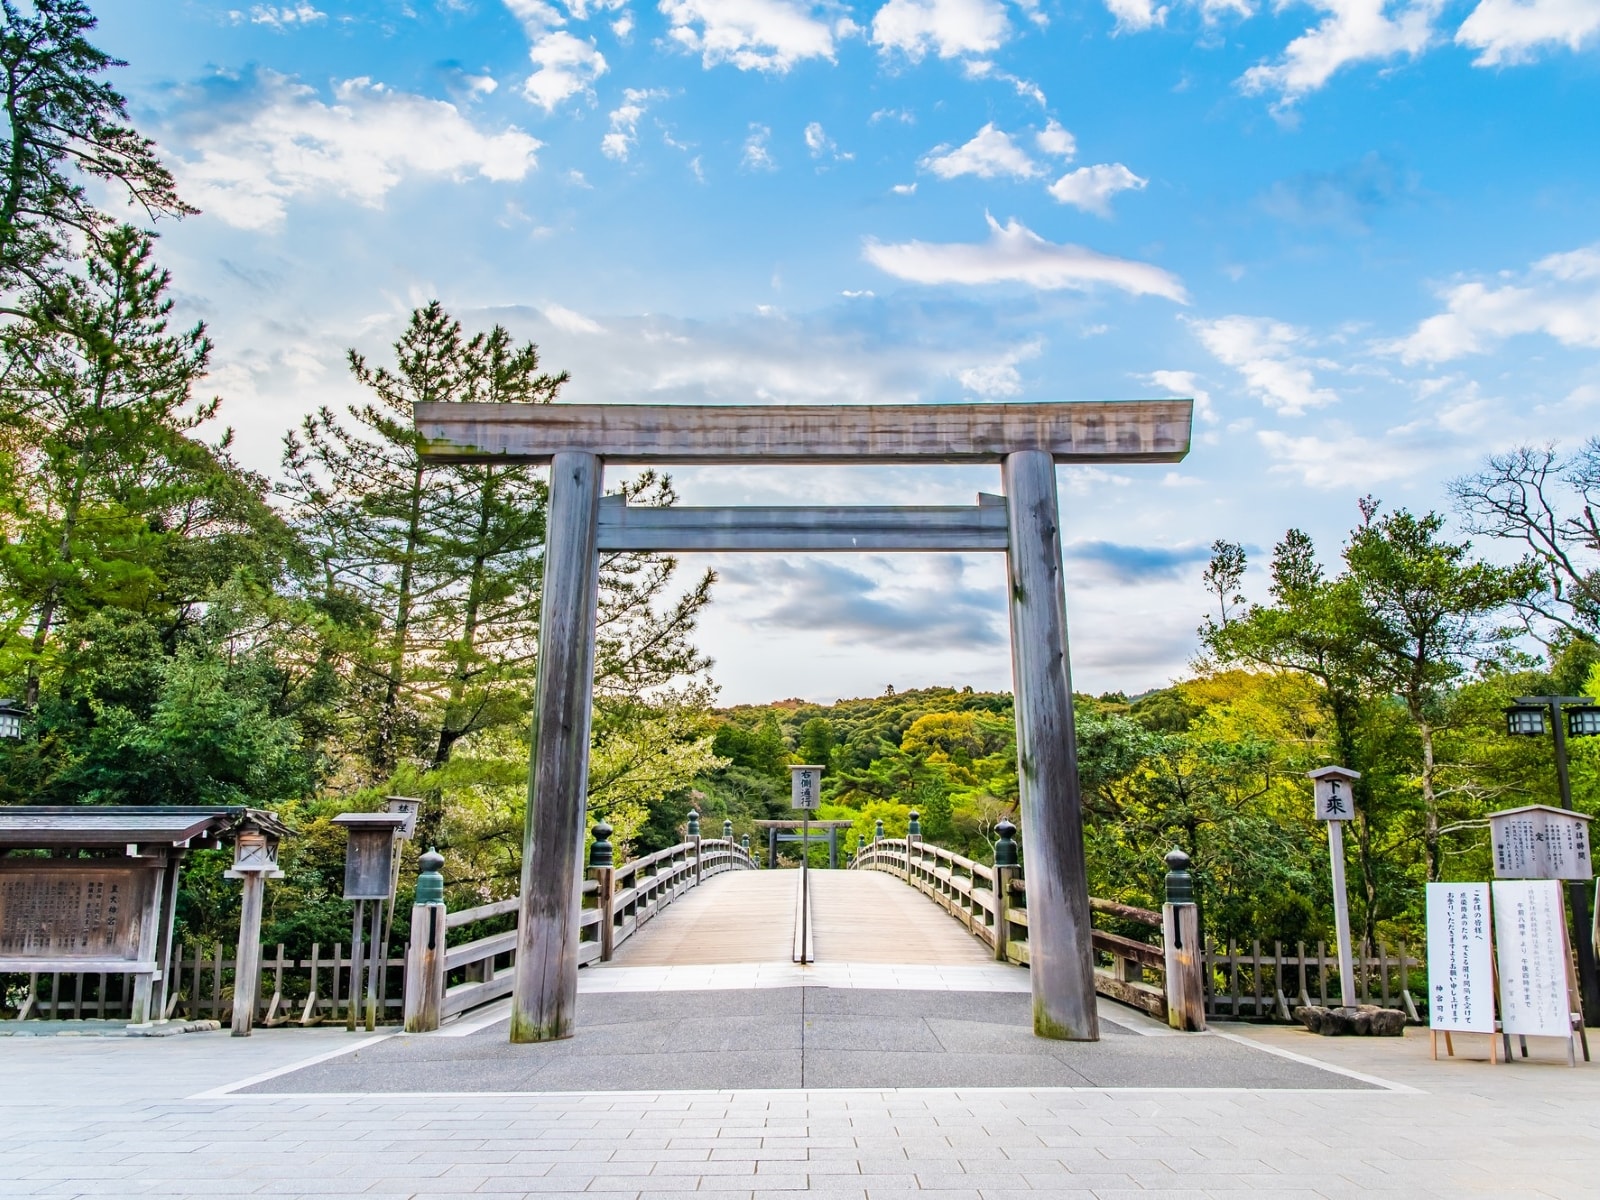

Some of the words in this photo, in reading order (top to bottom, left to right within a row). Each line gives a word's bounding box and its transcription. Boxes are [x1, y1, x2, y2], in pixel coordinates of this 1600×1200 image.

[800, 769, 812, 807] 右側通行
[1324, 779, 1347, 815] 下乗
[1535, 832, 1544, 842] 定
[1575, 821, 1586, 860] 参拝時間
[1473, 889, 1483, 940] ご参拝の皆様へ
[1447, 892, 1459, 1024] お参りいただきますようお願い申し上げます
[1435, 985, 1444, 1023] 神宮司庁
